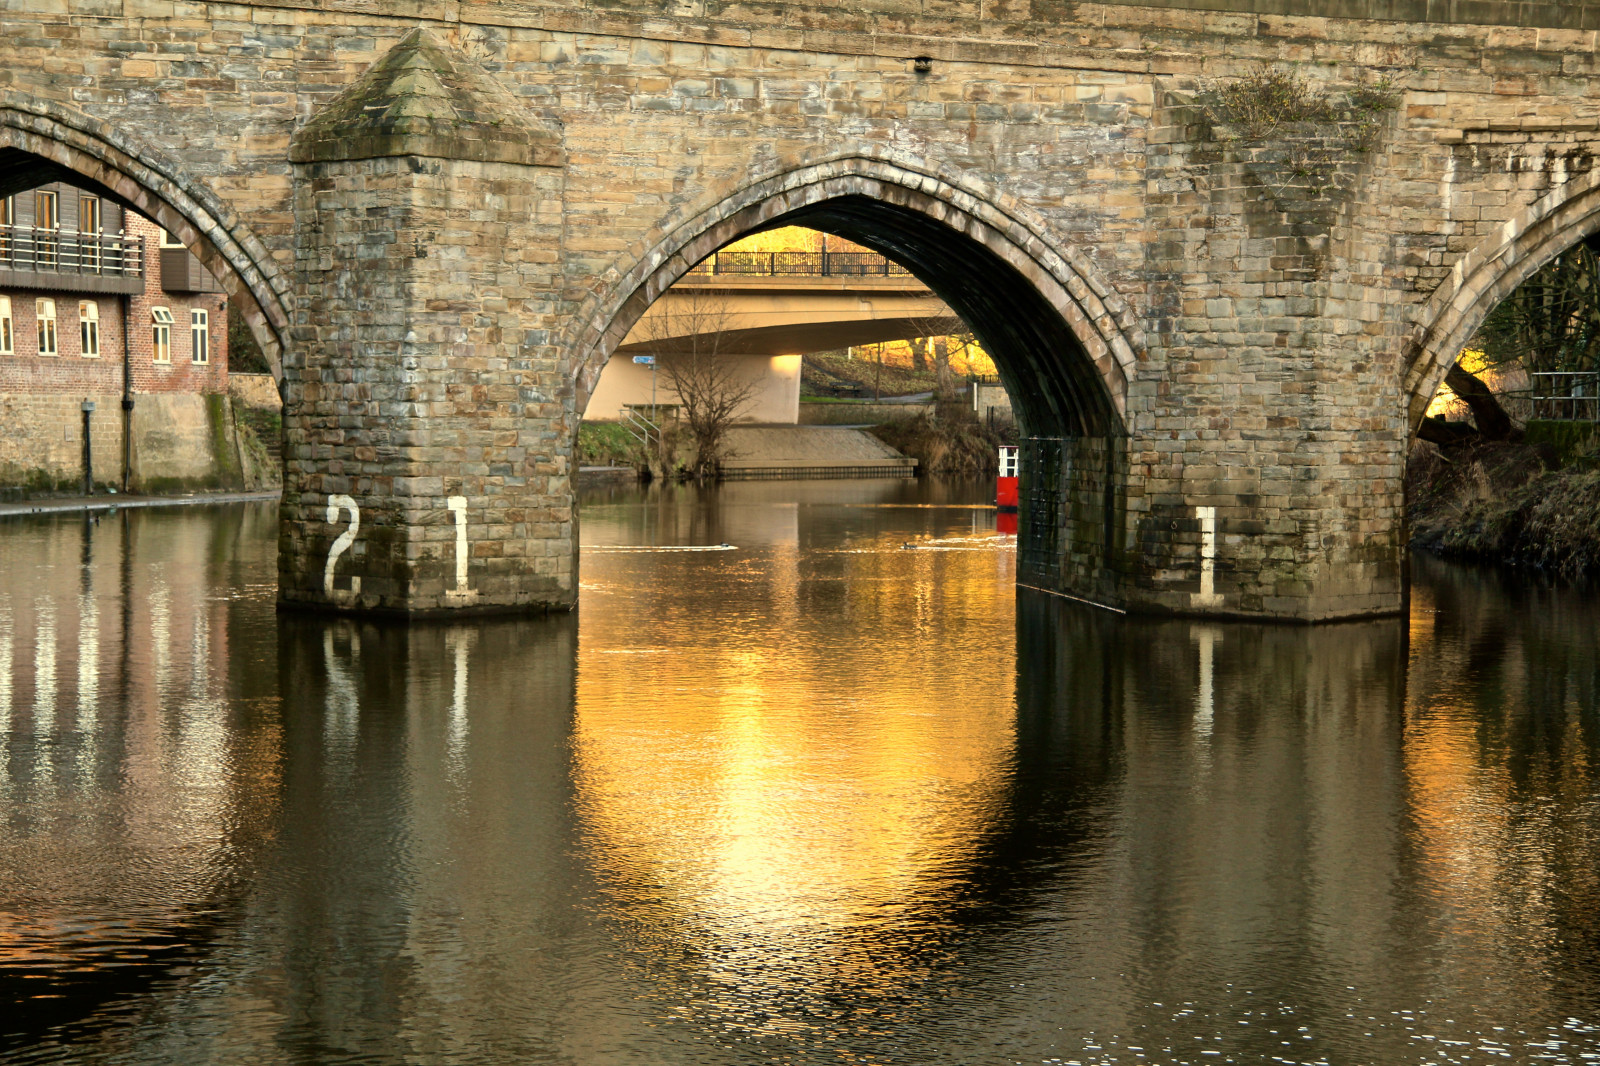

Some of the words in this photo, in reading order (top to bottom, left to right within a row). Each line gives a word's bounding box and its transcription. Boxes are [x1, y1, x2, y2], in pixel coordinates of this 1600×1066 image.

[324, 494, 362, 607] 2
[446, 496, 478, 607] 1
[1190, 507, 1224, 607] 1
